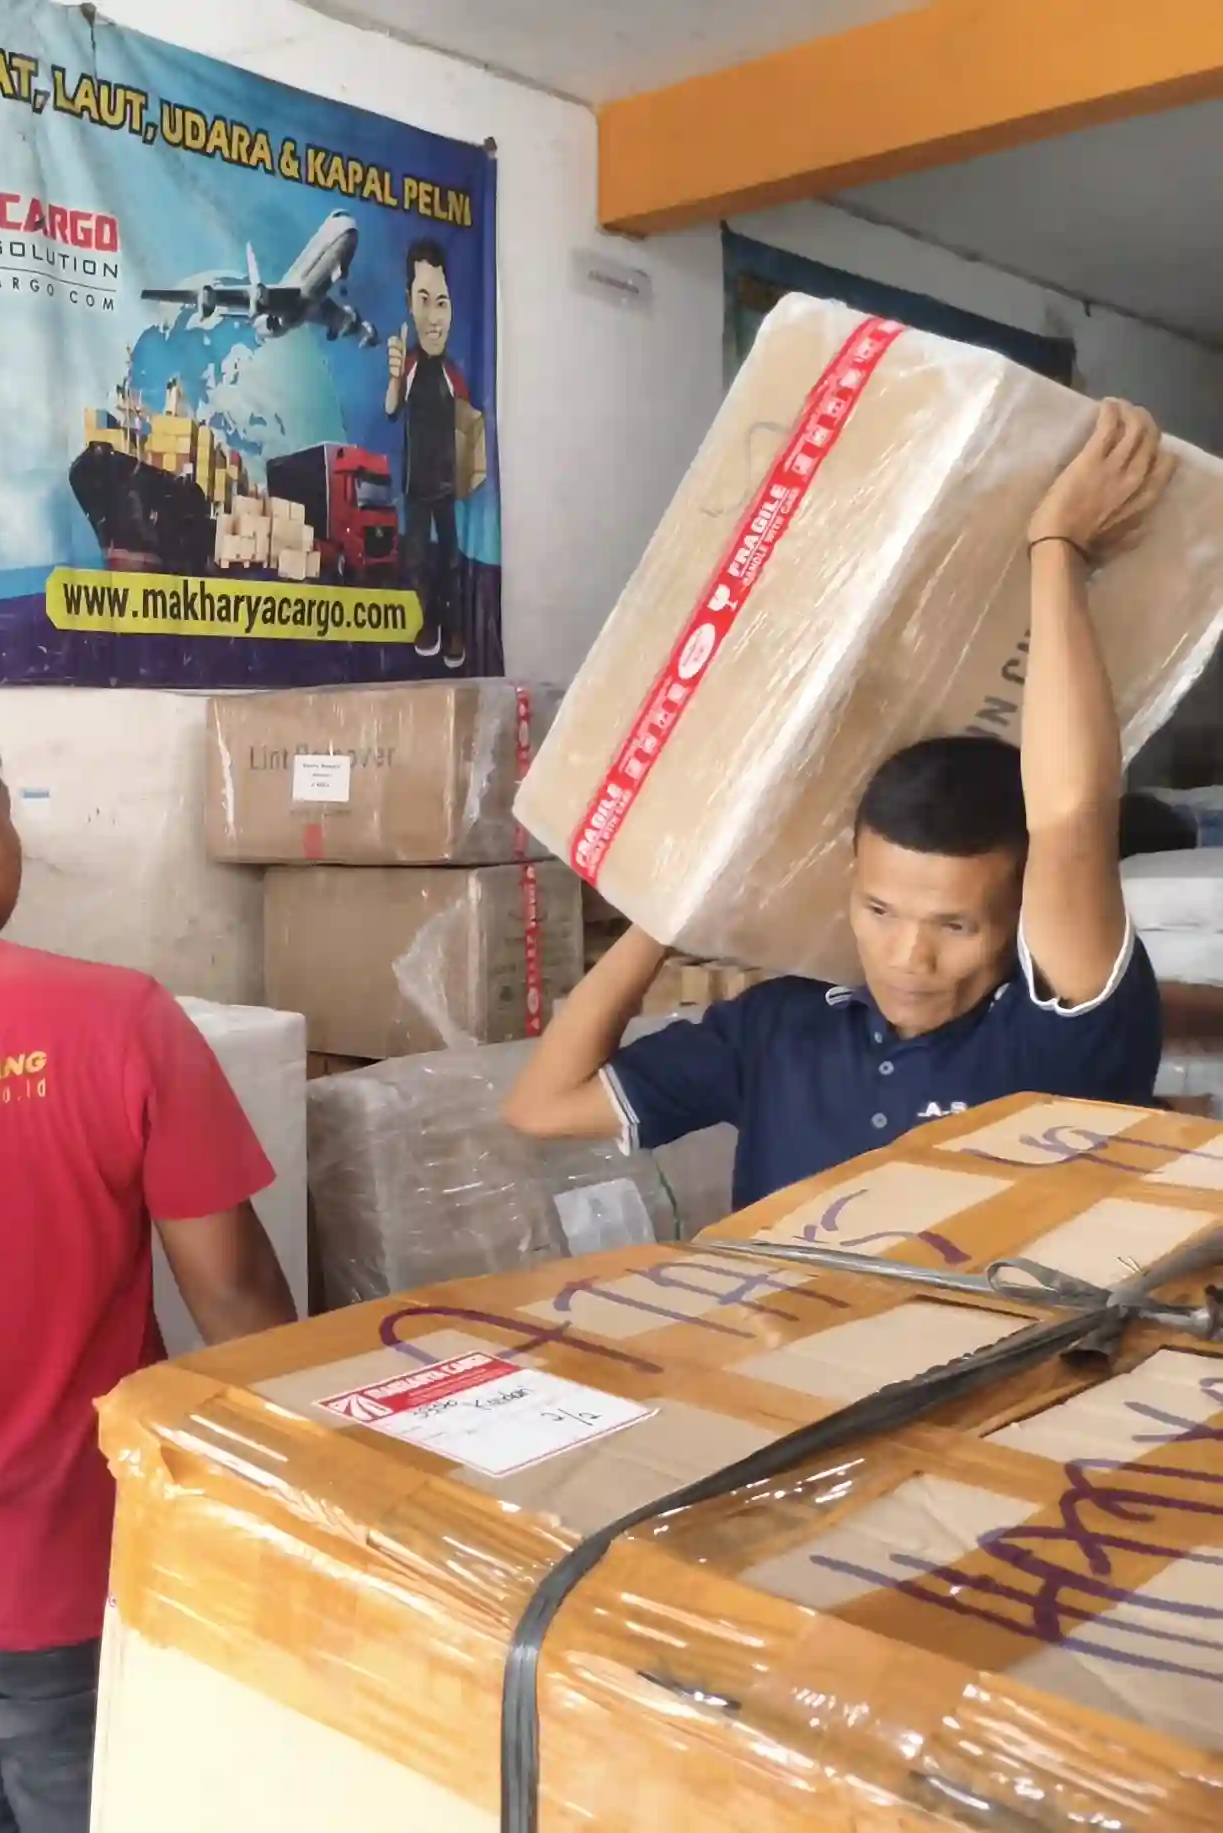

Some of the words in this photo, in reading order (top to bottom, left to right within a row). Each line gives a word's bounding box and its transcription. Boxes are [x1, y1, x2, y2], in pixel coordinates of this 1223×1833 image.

[51, 64, 158, 143] LAUT,
[161, 107, 274, 180] UDARA
[279, 141, 302, 181] &
[306, 146, 399, 209] KAPAL
[402, 172, 473, 229] PELNI
[728, 484, 786, 577] FRAGILE
[63, 581, 407, 636] www.makharyacargo.com
[249, 744, 289, 770] Lint
